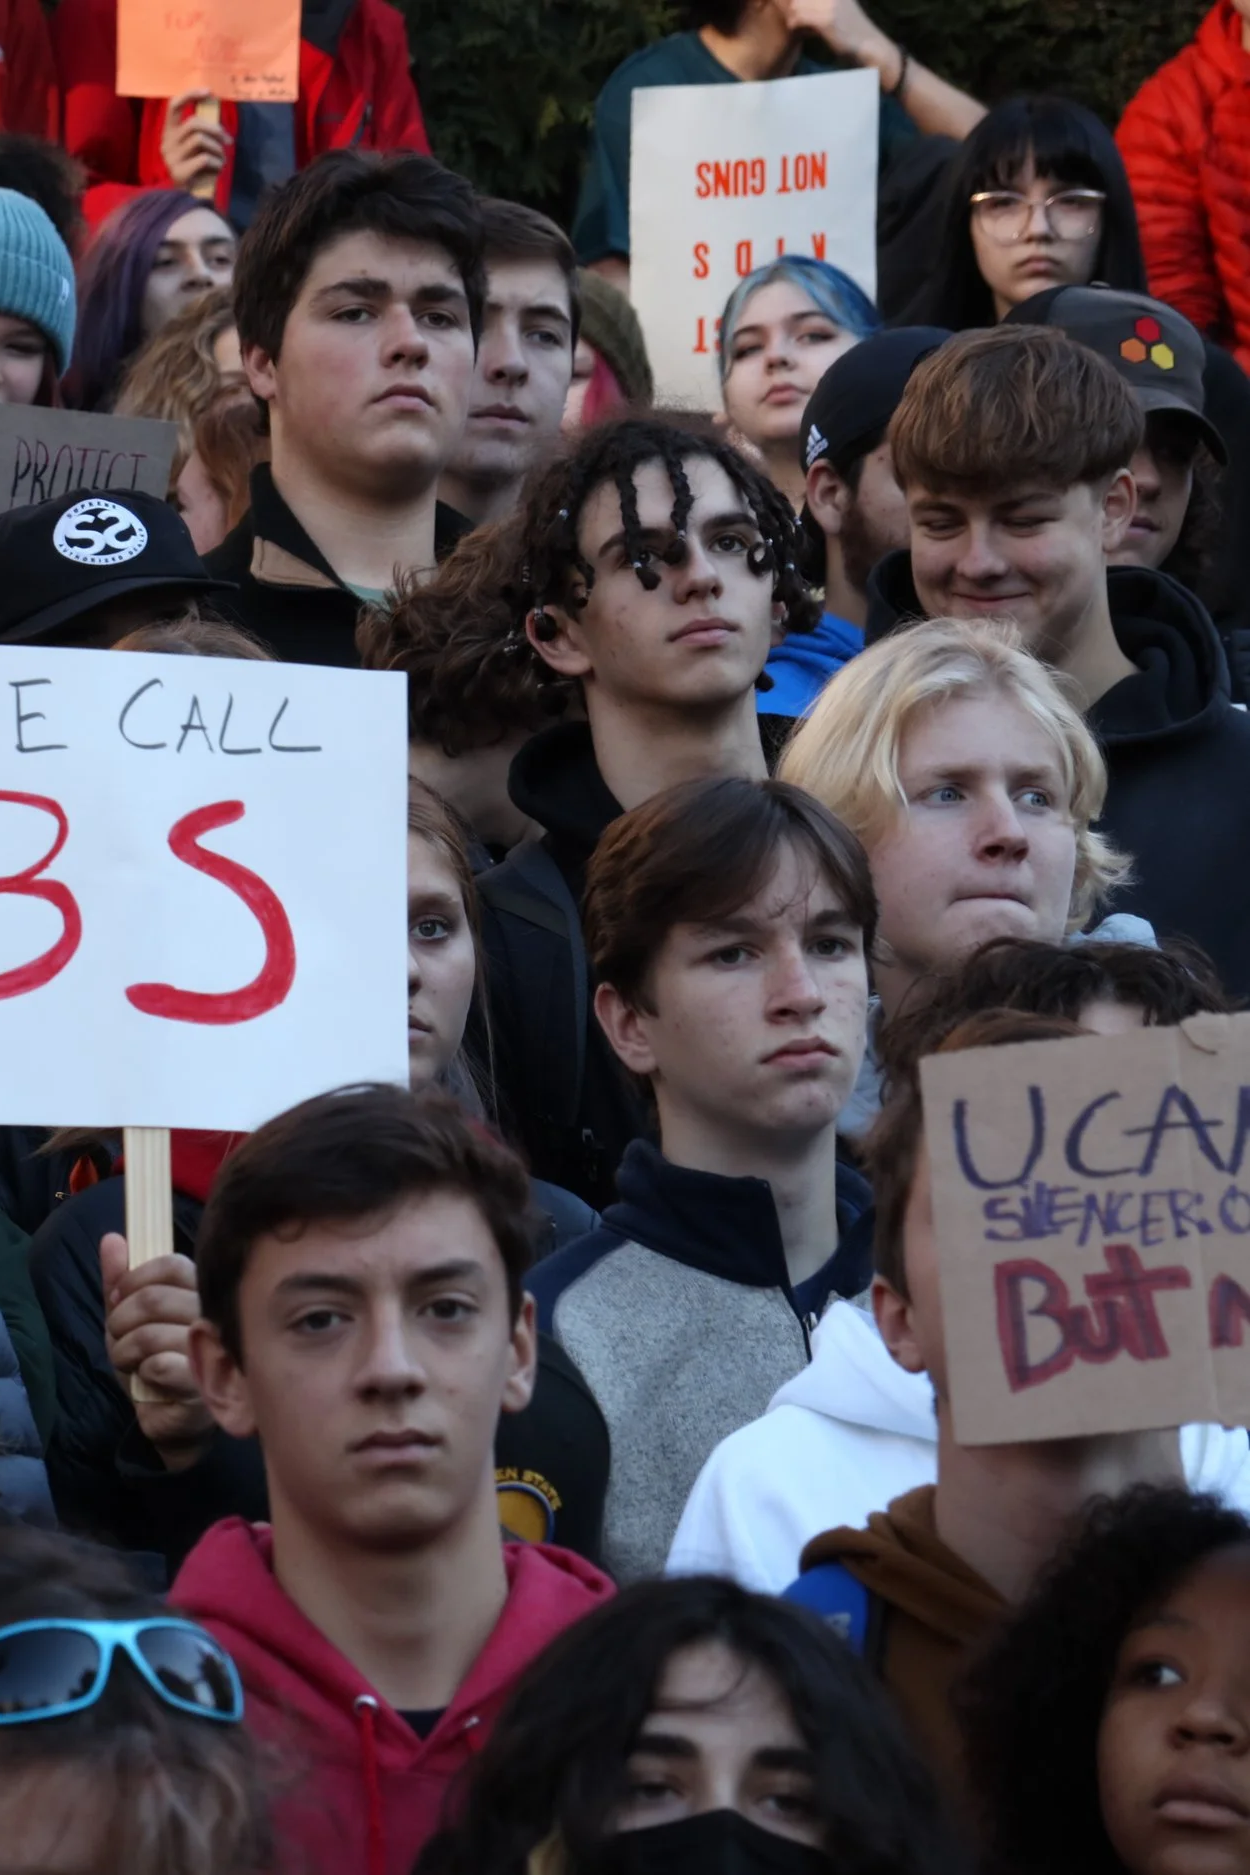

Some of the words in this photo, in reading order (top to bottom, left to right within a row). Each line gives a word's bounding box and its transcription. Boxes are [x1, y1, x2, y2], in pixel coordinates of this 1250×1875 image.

[695, 157, 766, 200] GUNS
[776, 151, 828, 194] NOT
[117, 677, 323, 756] CALL
